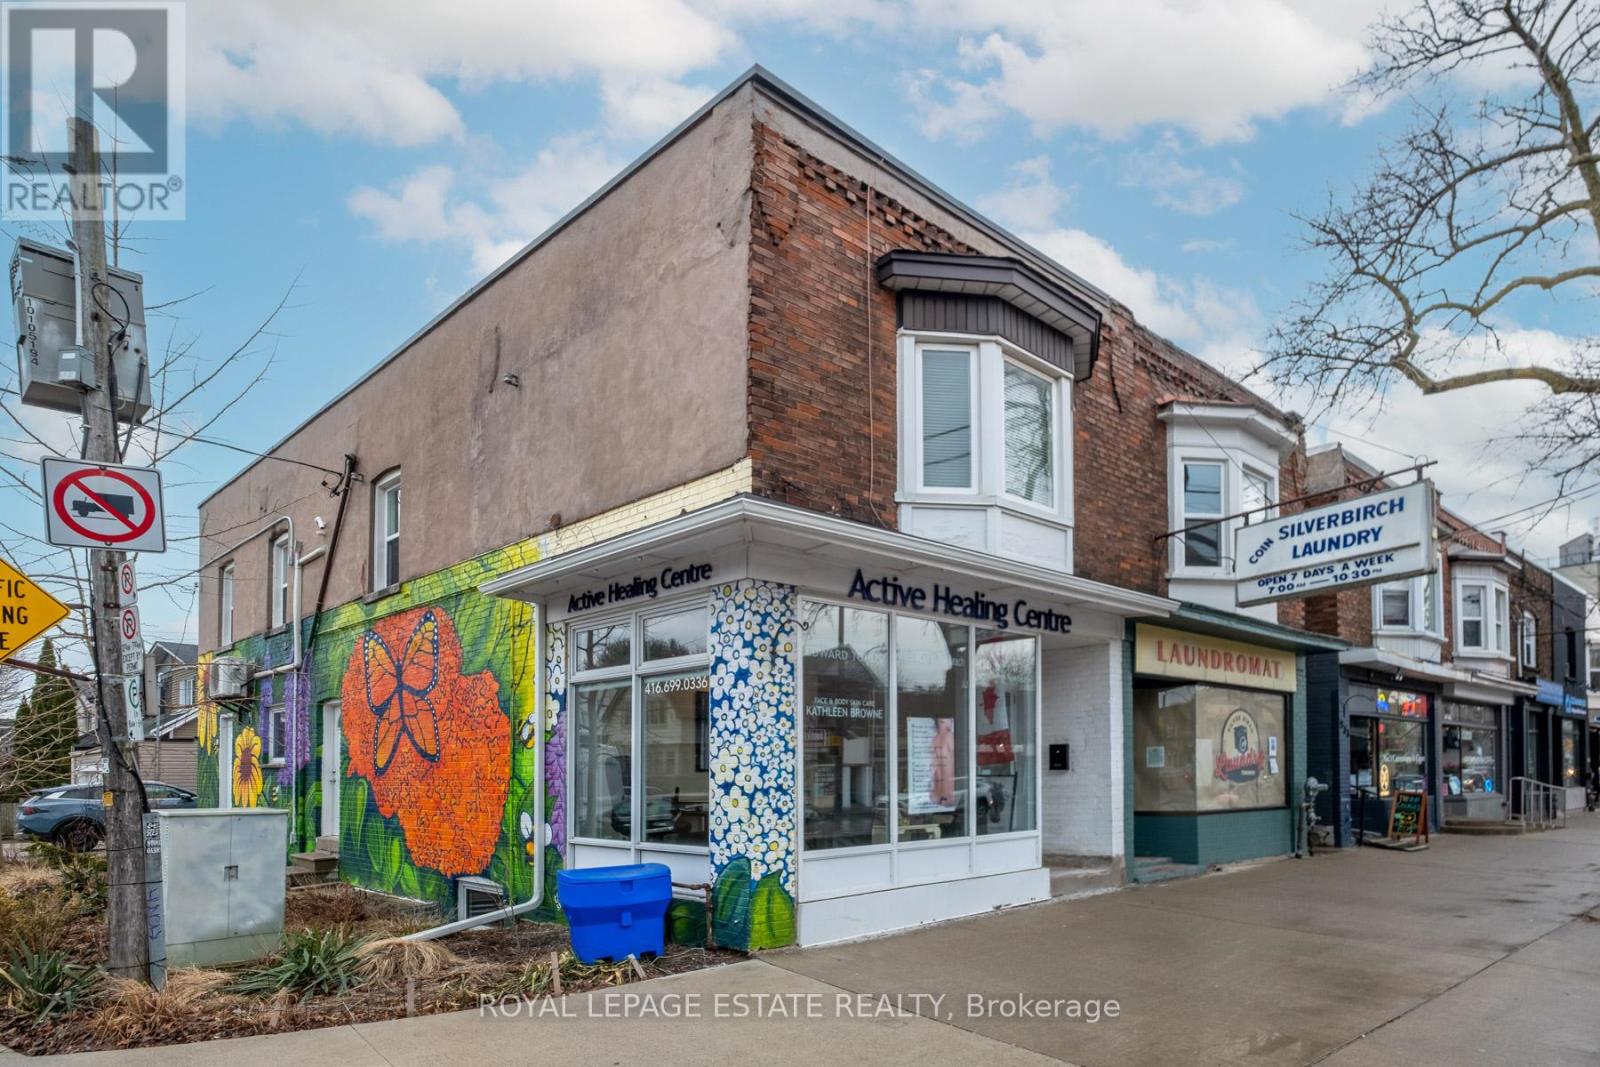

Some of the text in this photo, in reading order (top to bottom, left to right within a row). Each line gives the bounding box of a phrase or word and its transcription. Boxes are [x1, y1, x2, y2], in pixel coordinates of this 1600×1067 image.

[1278, 496, 1405, 541] SILVERBIRCH
[1248, 537, 1275, 565] COIN
[1291, 526, 1383, 560] LAUNDRY
[567, 563, 713, 613] Active Healing Centre
[1257, 553, 1395, 588] OPEN 7 DAYS A WEEK
[848, 568, 1073, 634] Active Healing Centre
[1156, 640, 1282, 679] LAUNDROMAT
[644, 676, 708, 695] 416.699.0336
[806, 705, 884, 719] KATHLEEN BROWNE
